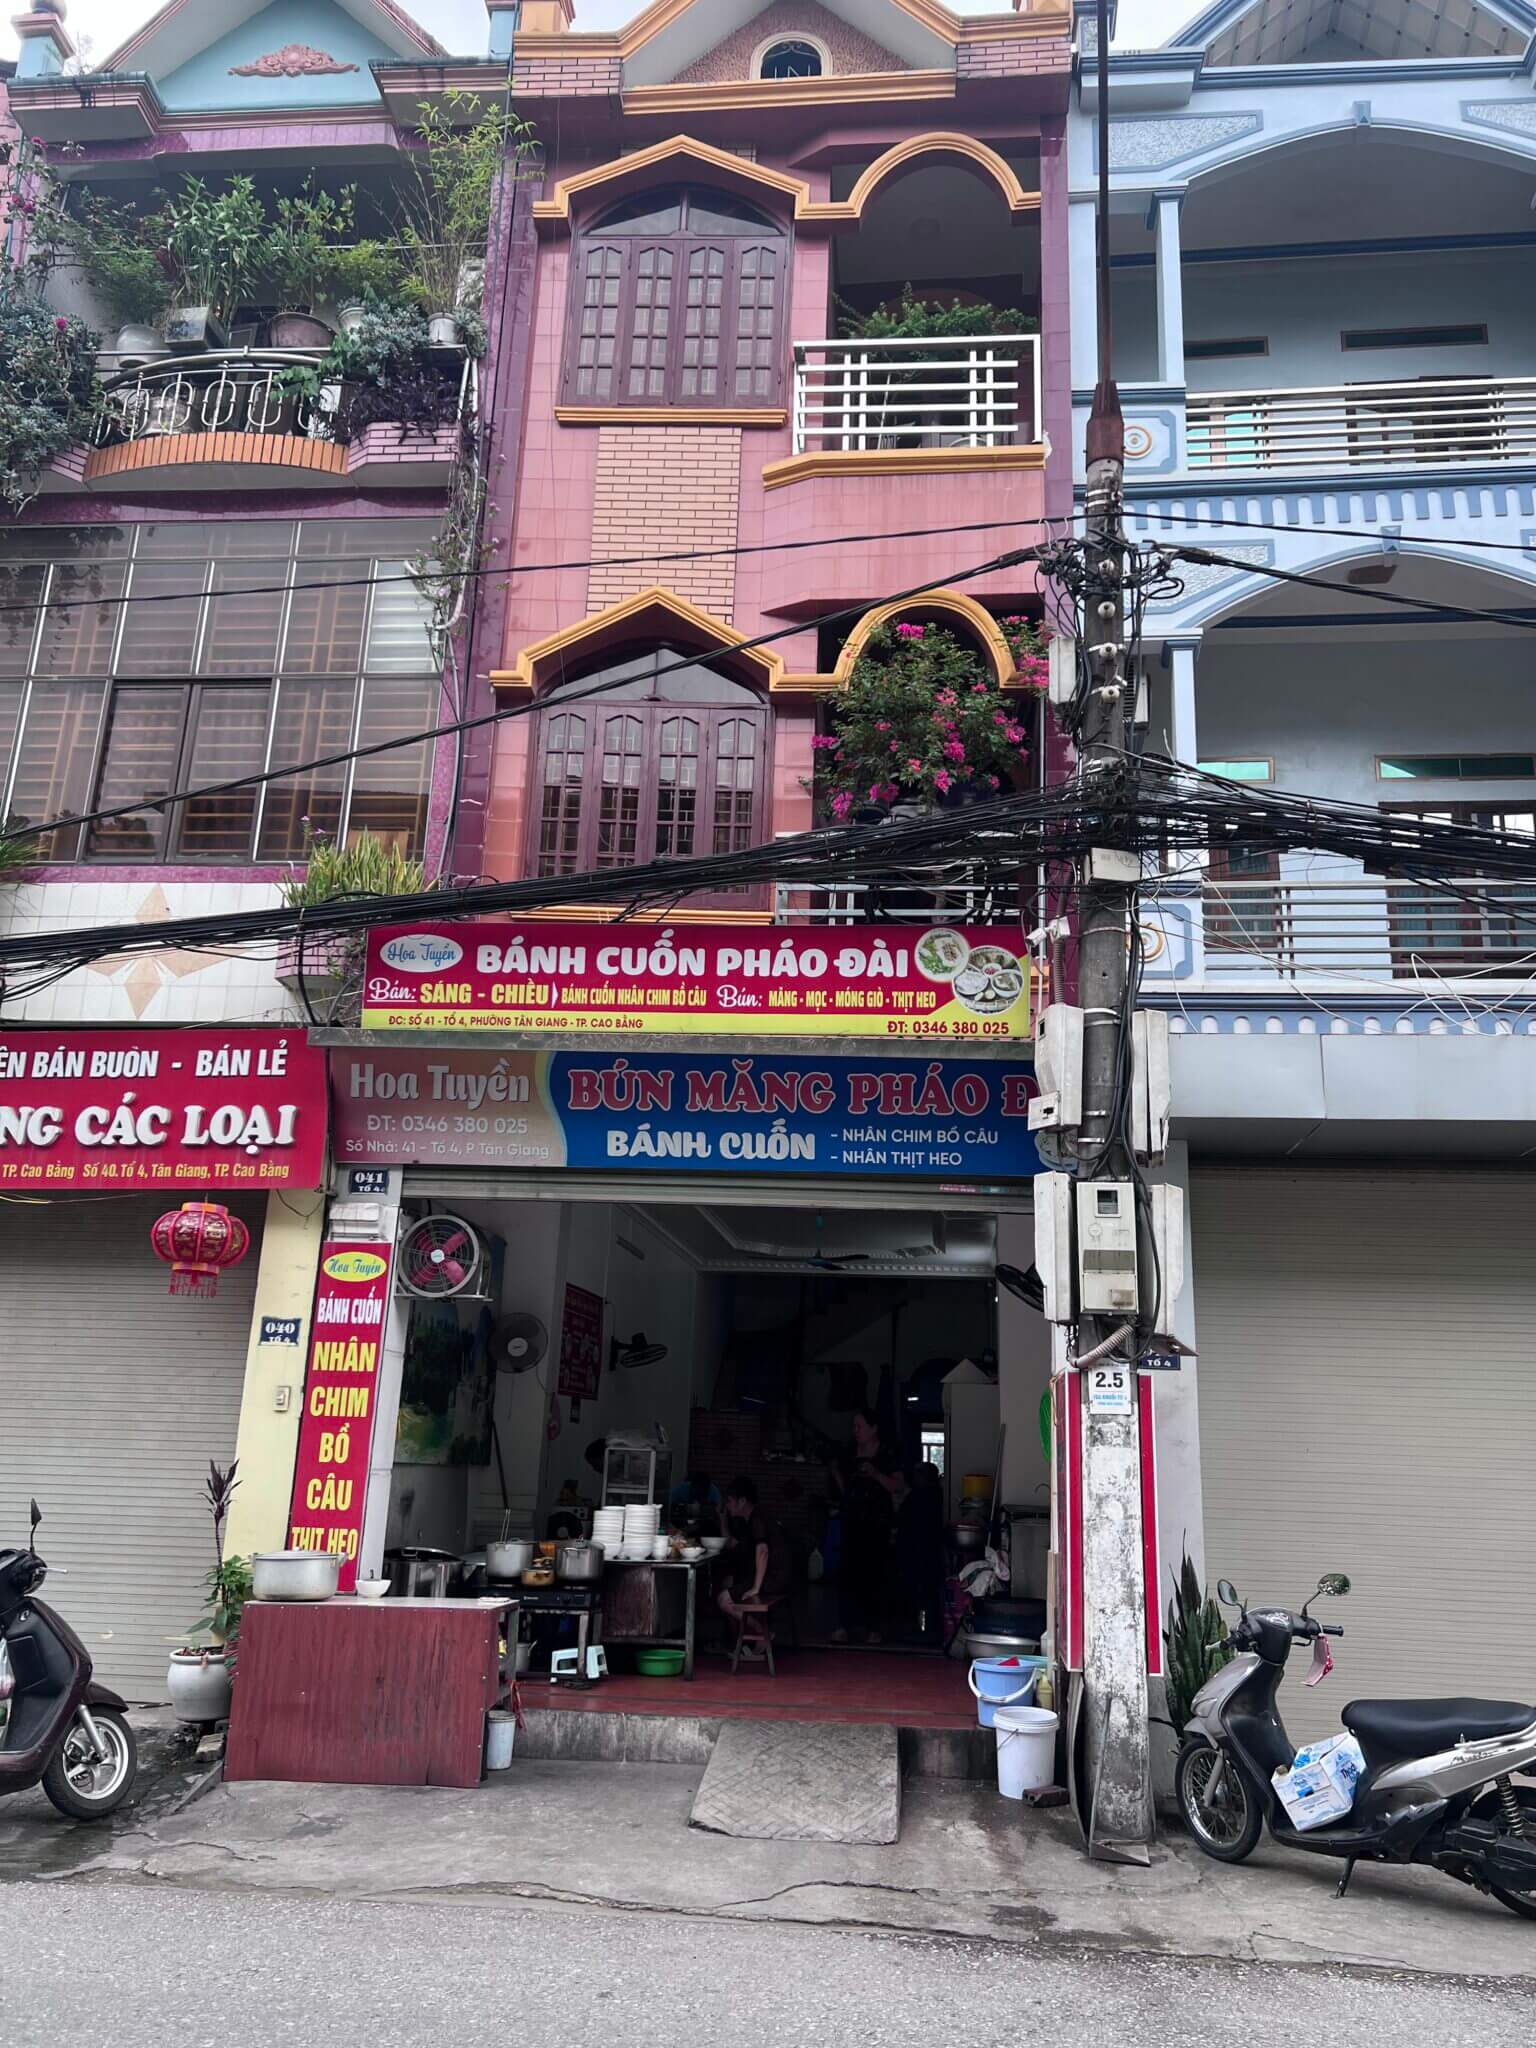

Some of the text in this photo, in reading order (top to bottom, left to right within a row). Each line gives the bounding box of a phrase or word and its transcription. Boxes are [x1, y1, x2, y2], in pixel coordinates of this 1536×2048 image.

[387, 943, 416, 962] Hoa
[477, 929, 908, 978] BÁNH CUỐN PHÁO ĐÀI
[368, 977, 417, 1000] Bán:
[420, 980, 472, 1004] SÁNG
[491, 978, 549, 1004] CHIỀU
[561, 983, 589, 1005] BÁNH
[590, 980, 616, 1005] CUỐN
[618, 984, 644, 1005] NHÂN
[646, 989, 671, 1006] CHIM
[688, 985, 706, 1006] CÂU
[716, 984, 763, 1008] Bún:
[806, 991, 827, 1012] MỌC
[835, 987, 864, 1008] MÓNG
[866, 987, 883, 1008] GIÒ
[892, 991, 913, 1012] THỊT
[916, 991, 936, 1009] HEO
[389, 1016, 406, 1025] ĐC:
[408, 1012, 422, 1025] SỐ
[424, 1016, 434, 1025] 41
[458, 1016, 467, 1027] 4,
[515, 1013, 532, 1026] TÂN
[536, 1017, 568, 1028] GIANG
[576, 1018, 588, 1028] TP.
[591, 1018, 613, 1028] CAO
[887, 1021, 1009, 1034] ĐT: 0346 380 025
[31, 1046, 85, 1078] BÁN
[195, 1044, 251, 1077] BÁN
[257, 1039, 288, 1076] LẺ
[350, 1057, 529, 1110] Hoa Tuyền
[568, 1058, 674, 1111] BÚN
[686, 1058, 836, 1114] MĂNG
[847, 1062, 989, 1116] PHÁO
[74, 1091, 171, 1146] CÁC
[180, 1104, 298, 1155] LOẠI
[367, 1115, 528, 1134] ĐT: 0346 380 025
[843, 1126, 886, 1142] NHÂN
[891, 1129, 932, 1143] CHIM
[964, 1128, 998, 1144] CÂU
[345, 1139, 363, 1152] Số
[401, 1141, 416, 1153] 41
[449, 1142, 462, 1155] 4,
[507, 1143, 549, 1159] Giang
[607, 1118, 816, 1161] BÁNH CUỐN
[2, 1164, 17, 1178] TP.
[21, 1164, 43, 1178] Cao
[82, 1162, 100, 1177] Số
[151, 1163, 171, 1177] Tân
[175, 1164, 211, 1179] Giang,
[233, 1164, 255, 1177] Cao
[843, 1148, 886, 1164] NHÂN
[891, 1151, 925, 1168] THỊT
[929, 1152, 962, 1165] HEO
[355, 1172, 383, 1183] 041
[329, 1258, 349, 1272] Hoa
[317, 1286, 382, 1324] BÁNH CUỐN
[265, 1322, 295, 1334] 040
[312, 1336, 376, 1372] NHÂN
[1095, 1371, 1124, 1388] 2.5
[310, 1386, 369, 1417] CHIM
[306, 1472, 352, 1511] CÂU
